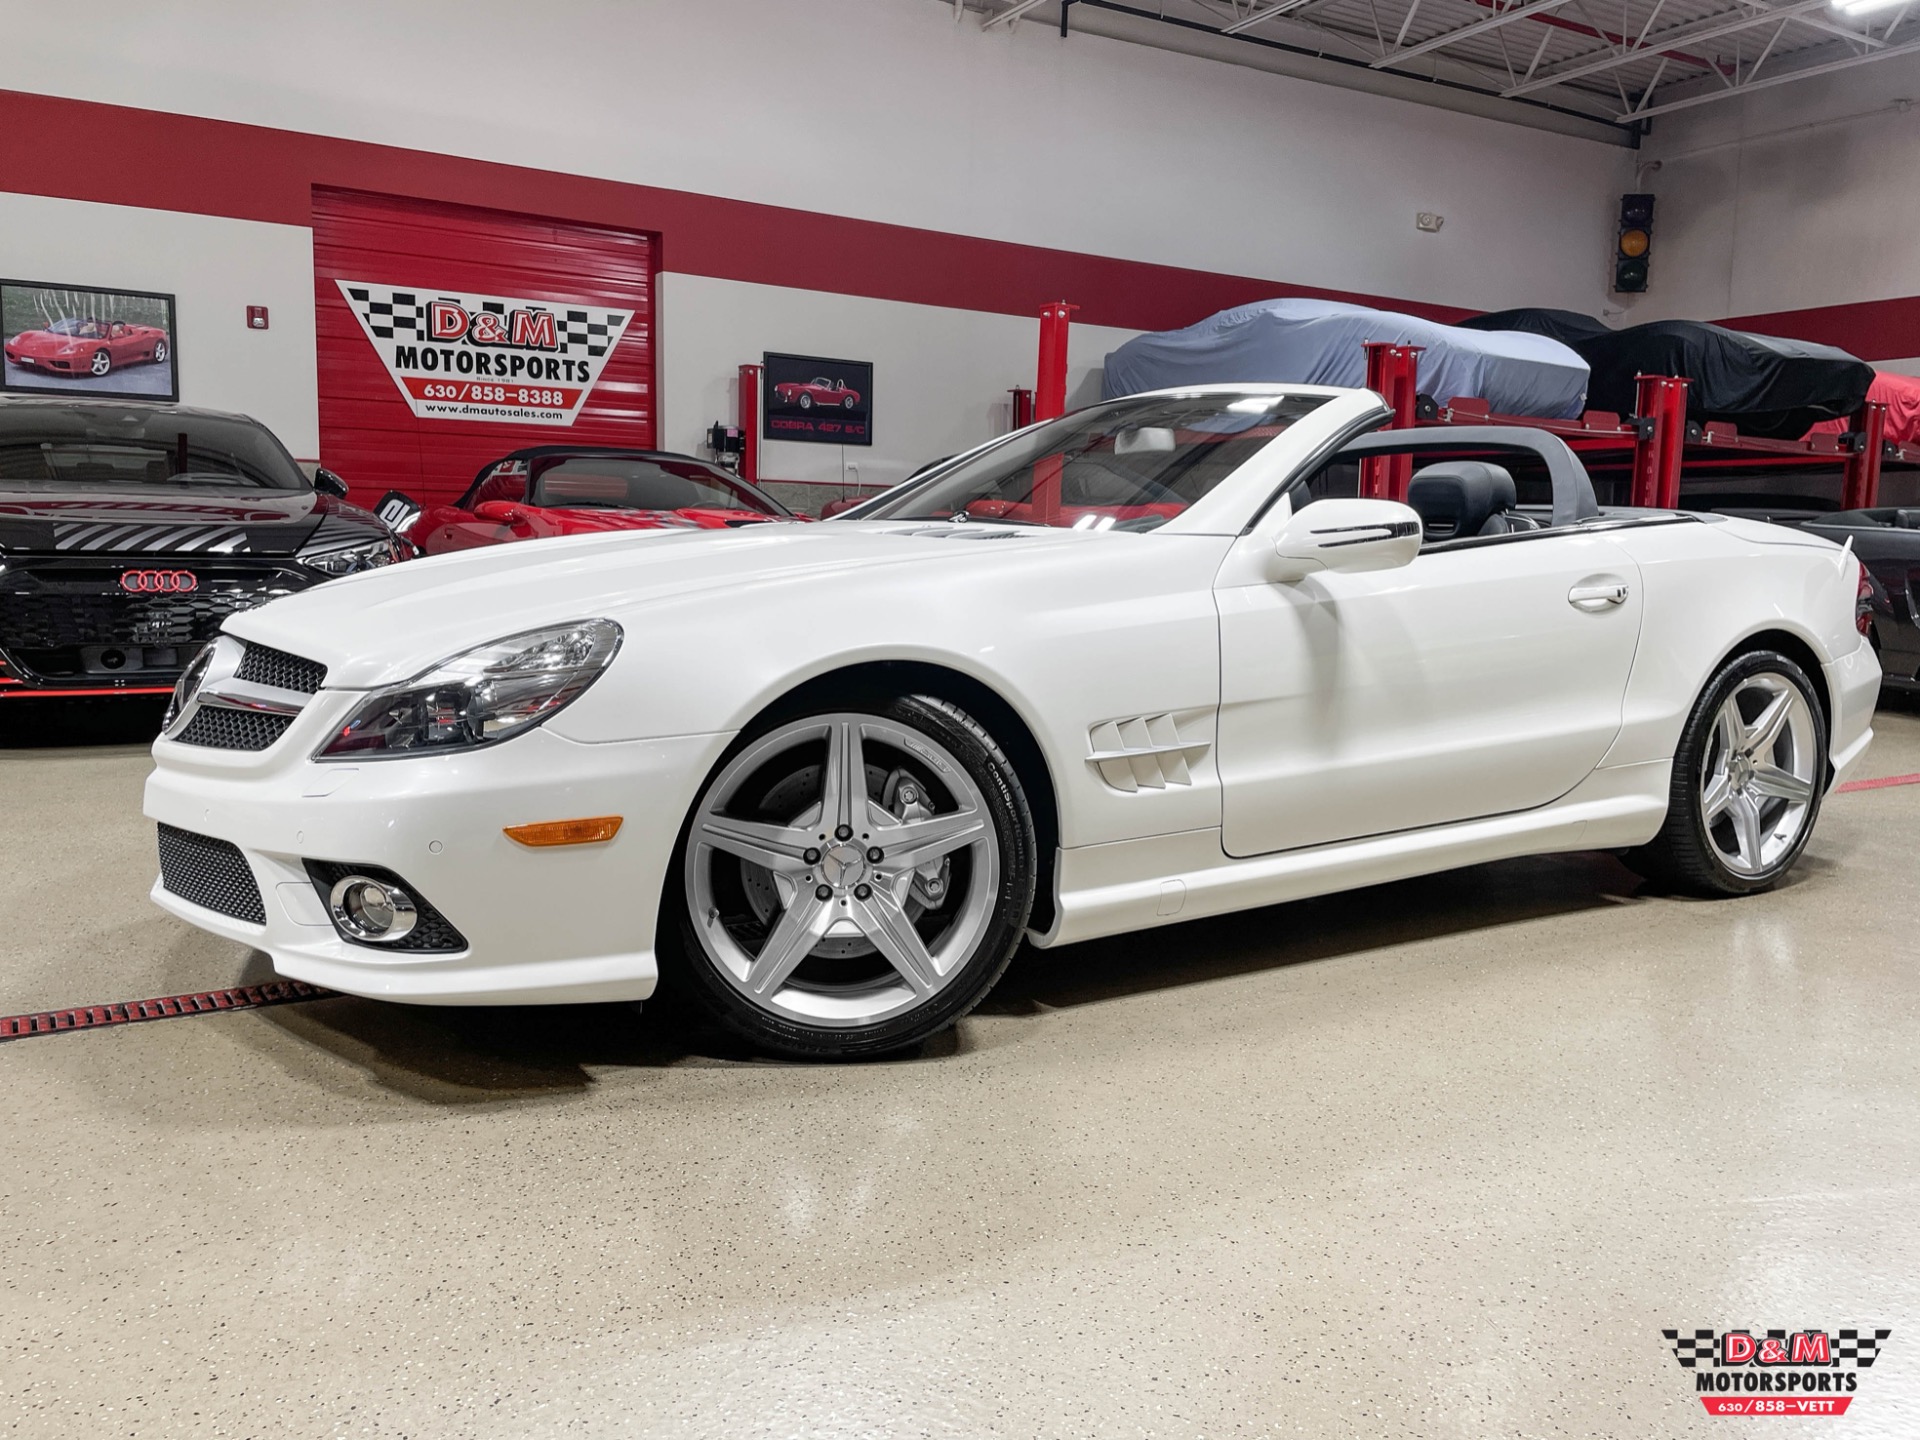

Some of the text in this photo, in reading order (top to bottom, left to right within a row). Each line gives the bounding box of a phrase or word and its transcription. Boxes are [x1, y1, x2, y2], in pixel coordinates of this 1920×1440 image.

[427, 301, 560, 350] D&M
[395, 345, 589, 382] MOTORSPORTS
[424, 384, 563, 405] 630/858-8388
[425, 403, 563, 420] www.dmautosales.com
[771, 420, 865, 435] COBRA 427 S/C
